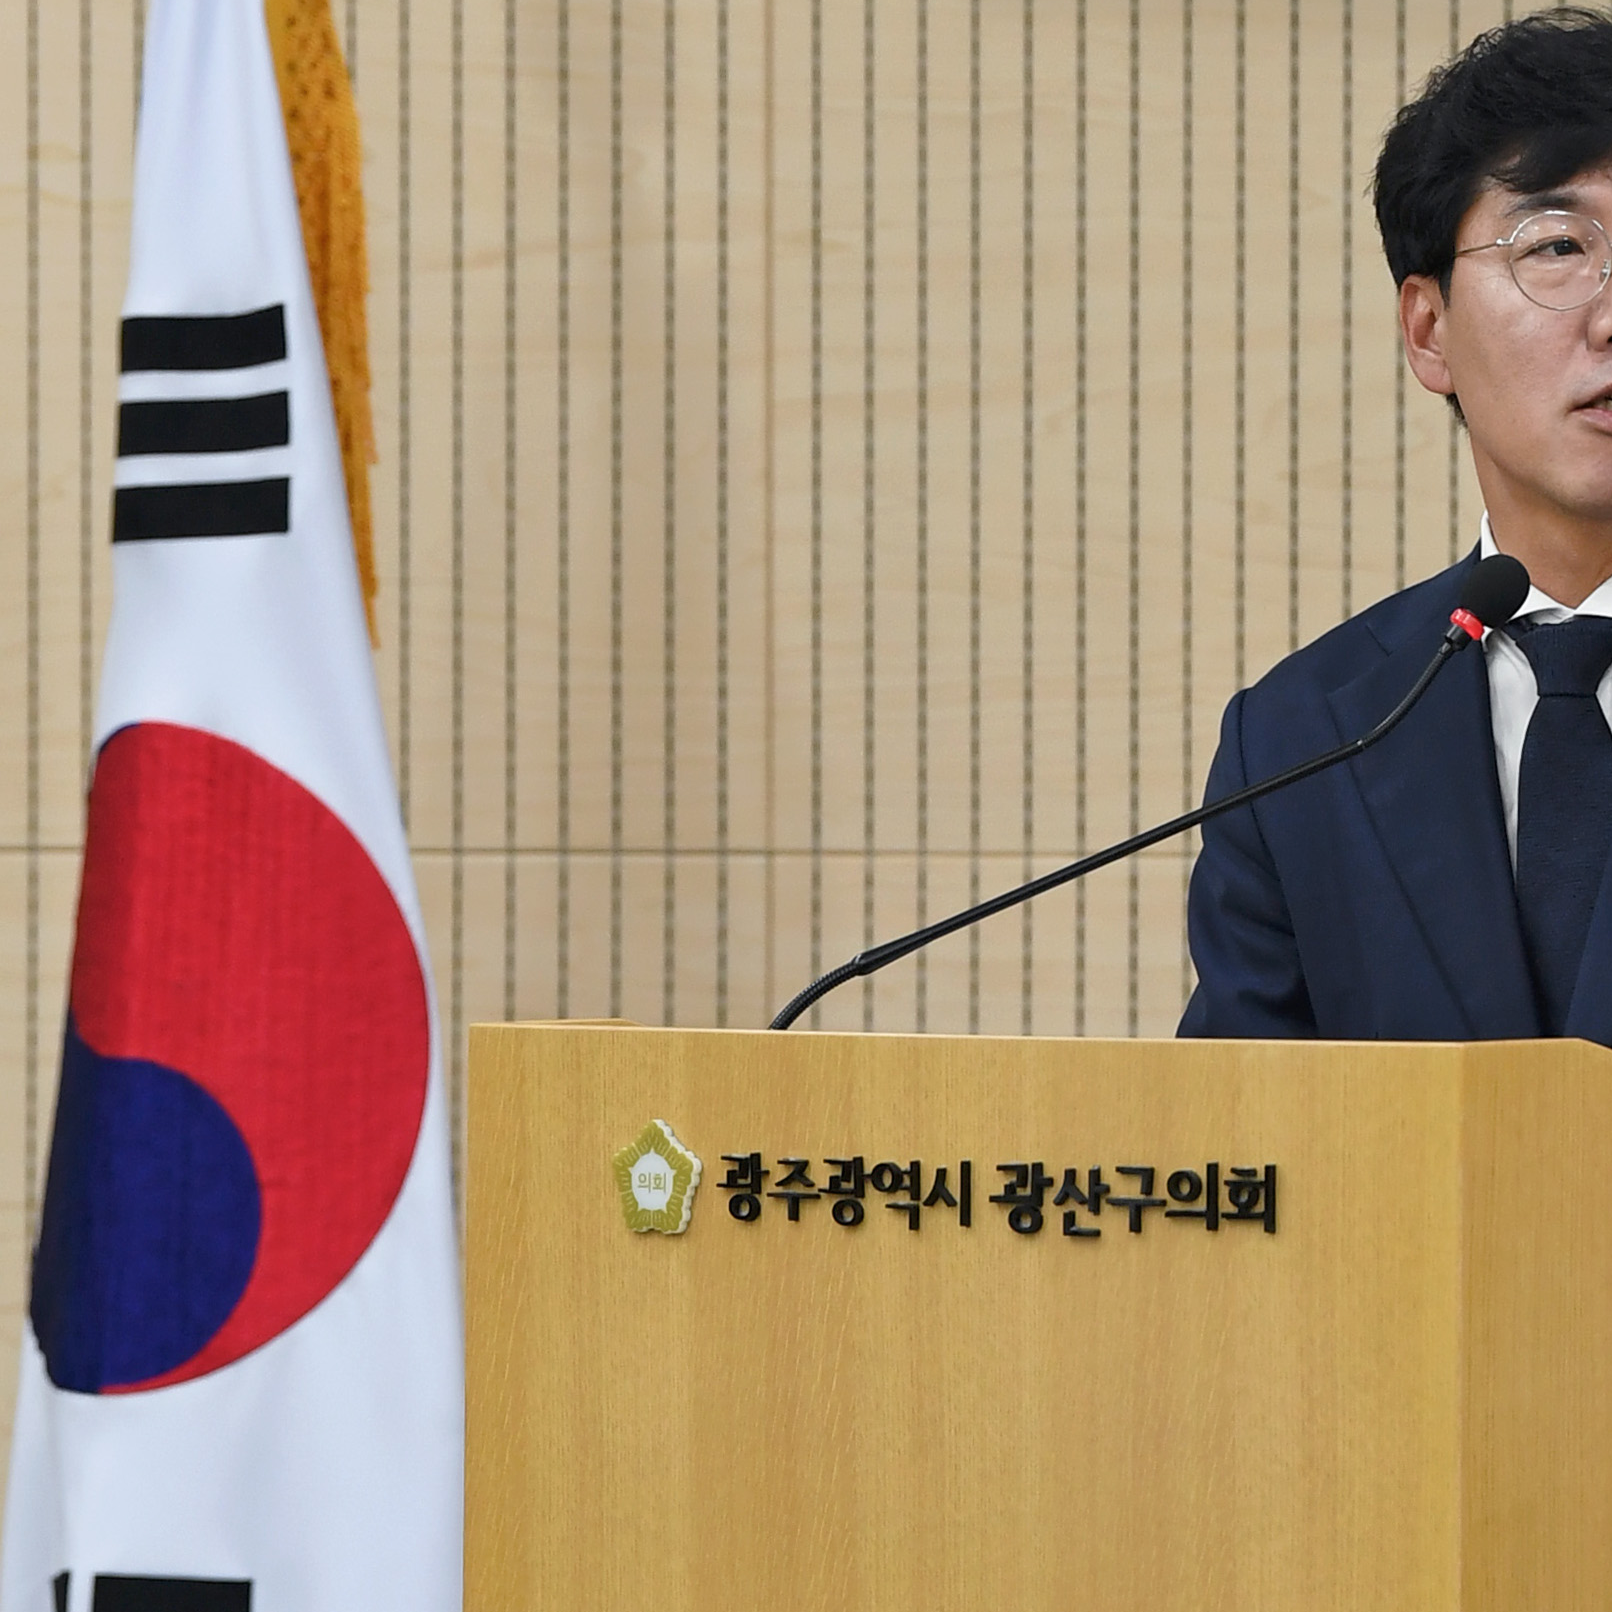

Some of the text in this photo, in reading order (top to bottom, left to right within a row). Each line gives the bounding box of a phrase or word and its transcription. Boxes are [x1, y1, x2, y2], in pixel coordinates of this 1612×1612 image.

[637, 1172, 667, 1194] 의회
[716, 1151, 1277, 1237] 광주광역시 광산구의회
